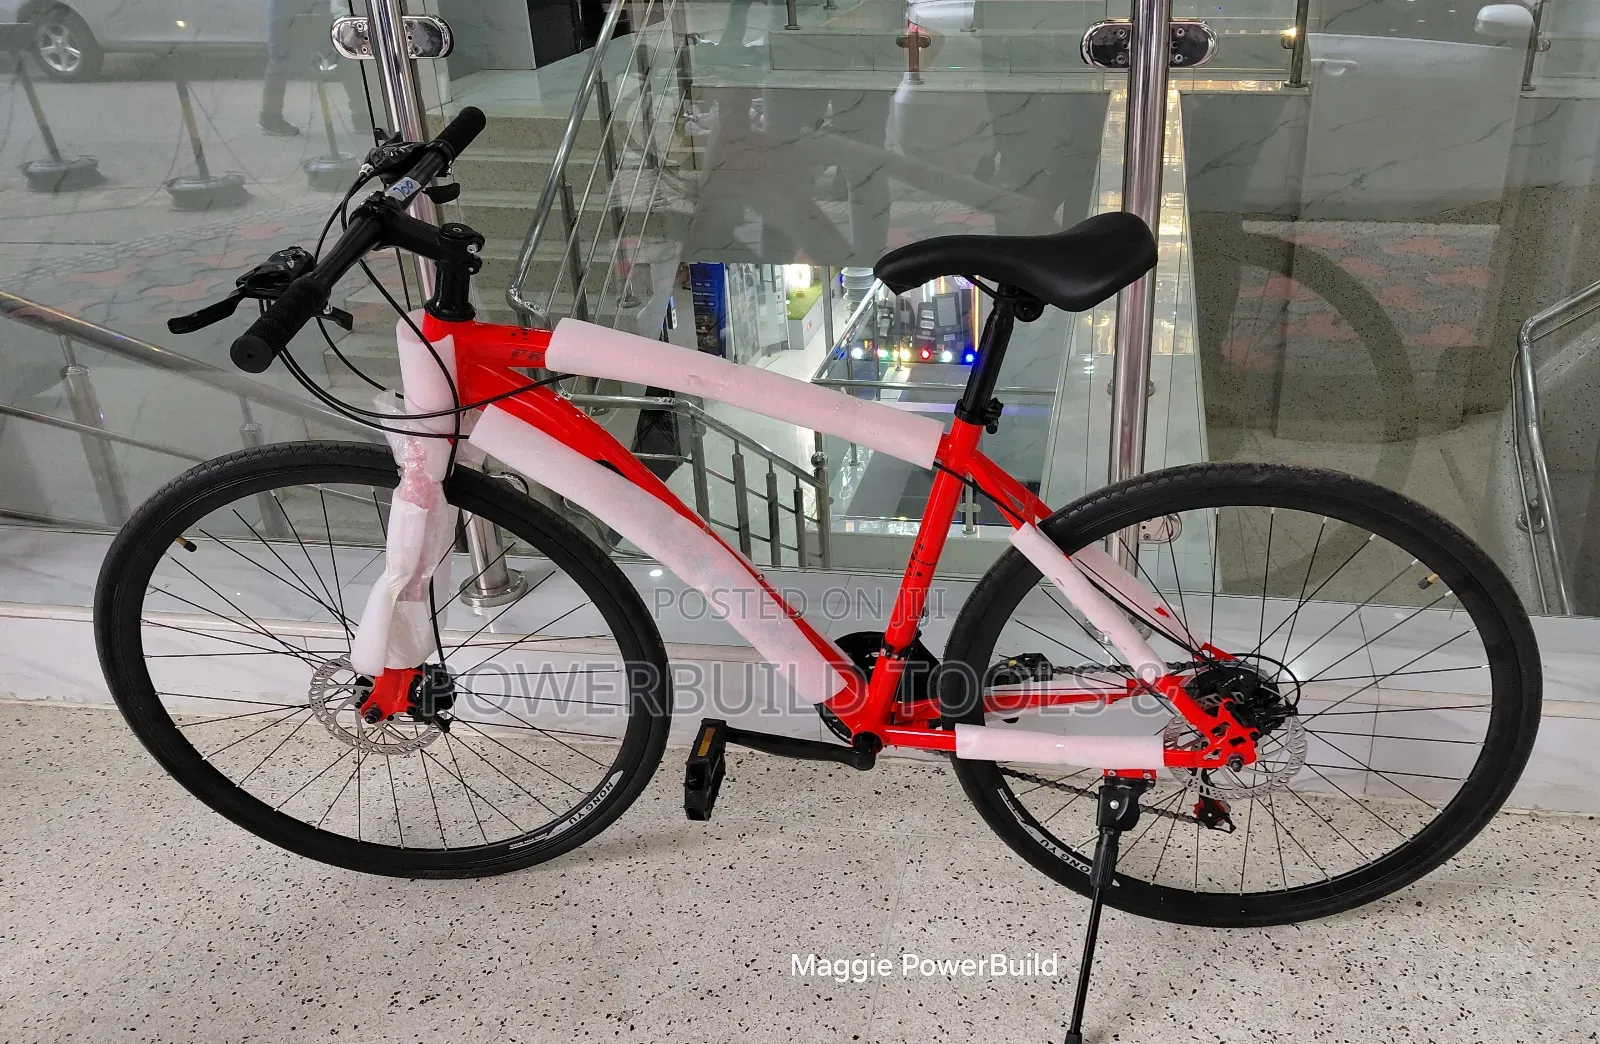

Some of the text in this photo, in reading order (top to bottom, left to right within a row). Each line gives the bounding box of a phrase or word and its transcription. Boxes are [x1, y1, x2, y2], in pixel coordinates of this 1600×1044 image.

[569, 781, 614, 825] HONG YU
[1040, 839, 1090, 873] ONG YU
